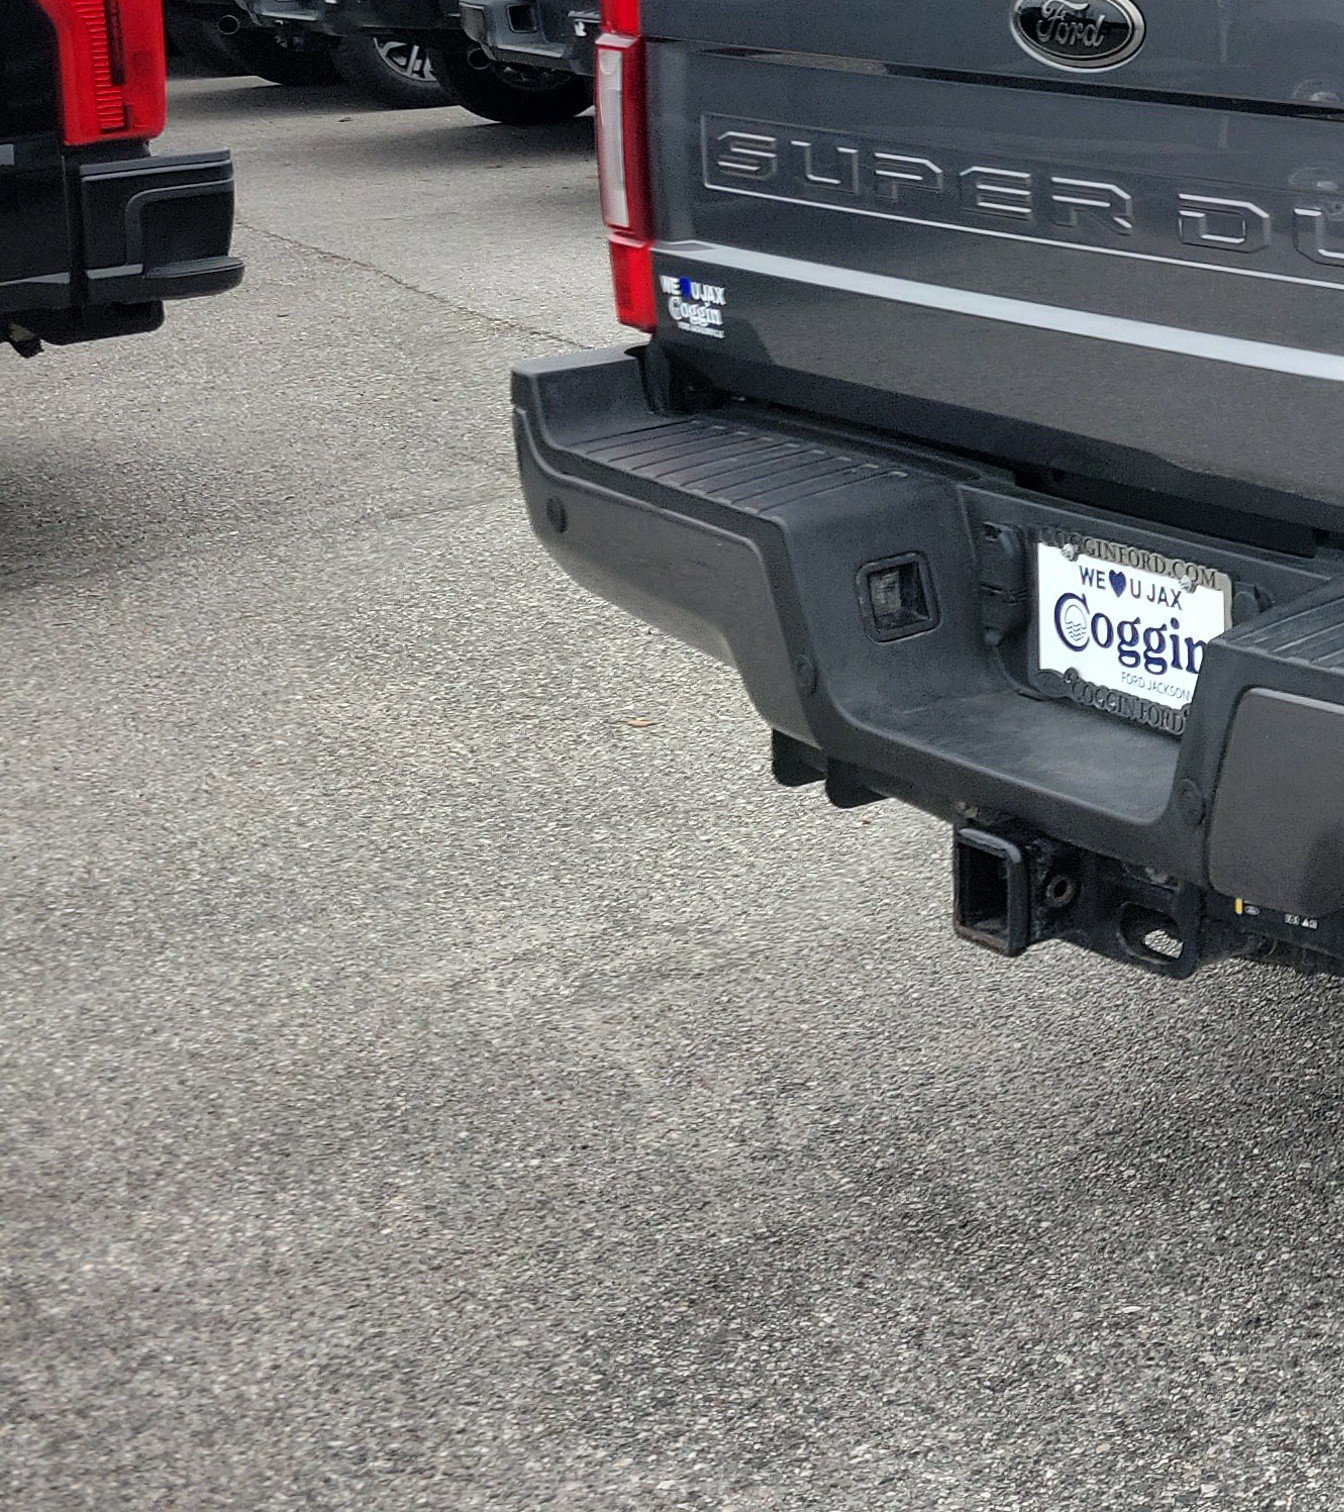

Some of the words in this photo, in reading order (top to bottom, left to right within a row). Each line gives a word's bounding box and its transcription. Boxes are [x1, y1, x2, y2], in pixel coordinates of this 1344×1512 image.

[716, 130, 1134, 236] SUPER
[660, 275, 681, 295] WE
[668, 296, 723, 327] Coggin
[1079, 565, 1107, 590] WE
[1129, 578, 1142, 599] U
[1146, 584, 1183, 611] JAX
[1053, 592, 1207, 676] Coggin
[1120, 671, 1146, 689] FORD
